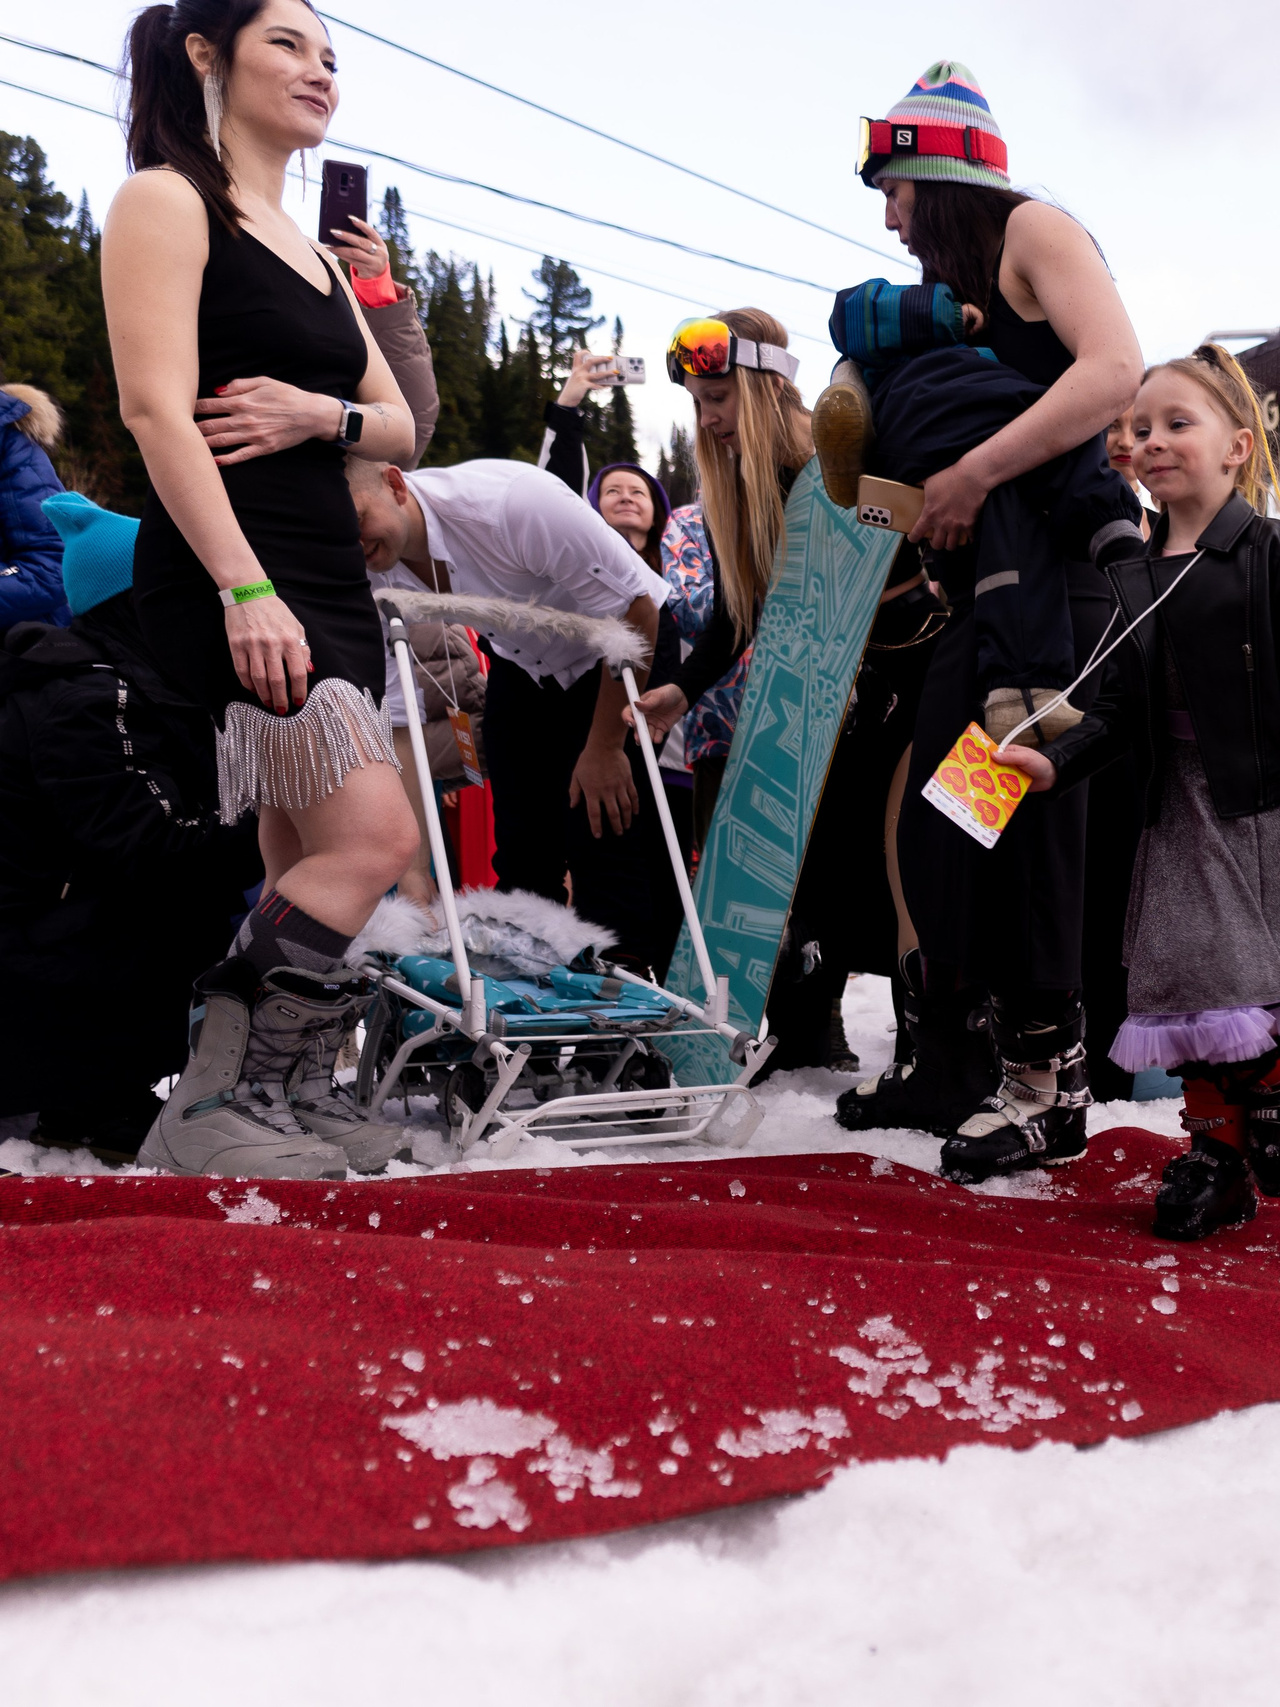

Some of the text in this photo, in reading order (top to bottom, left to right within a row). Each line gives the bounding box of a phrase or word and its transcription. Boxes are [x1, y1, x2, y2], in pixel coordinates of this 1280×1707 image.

[235, 584, 273, 598] MAXBUS
[116, 689, 127, 735] COOL ZONE
